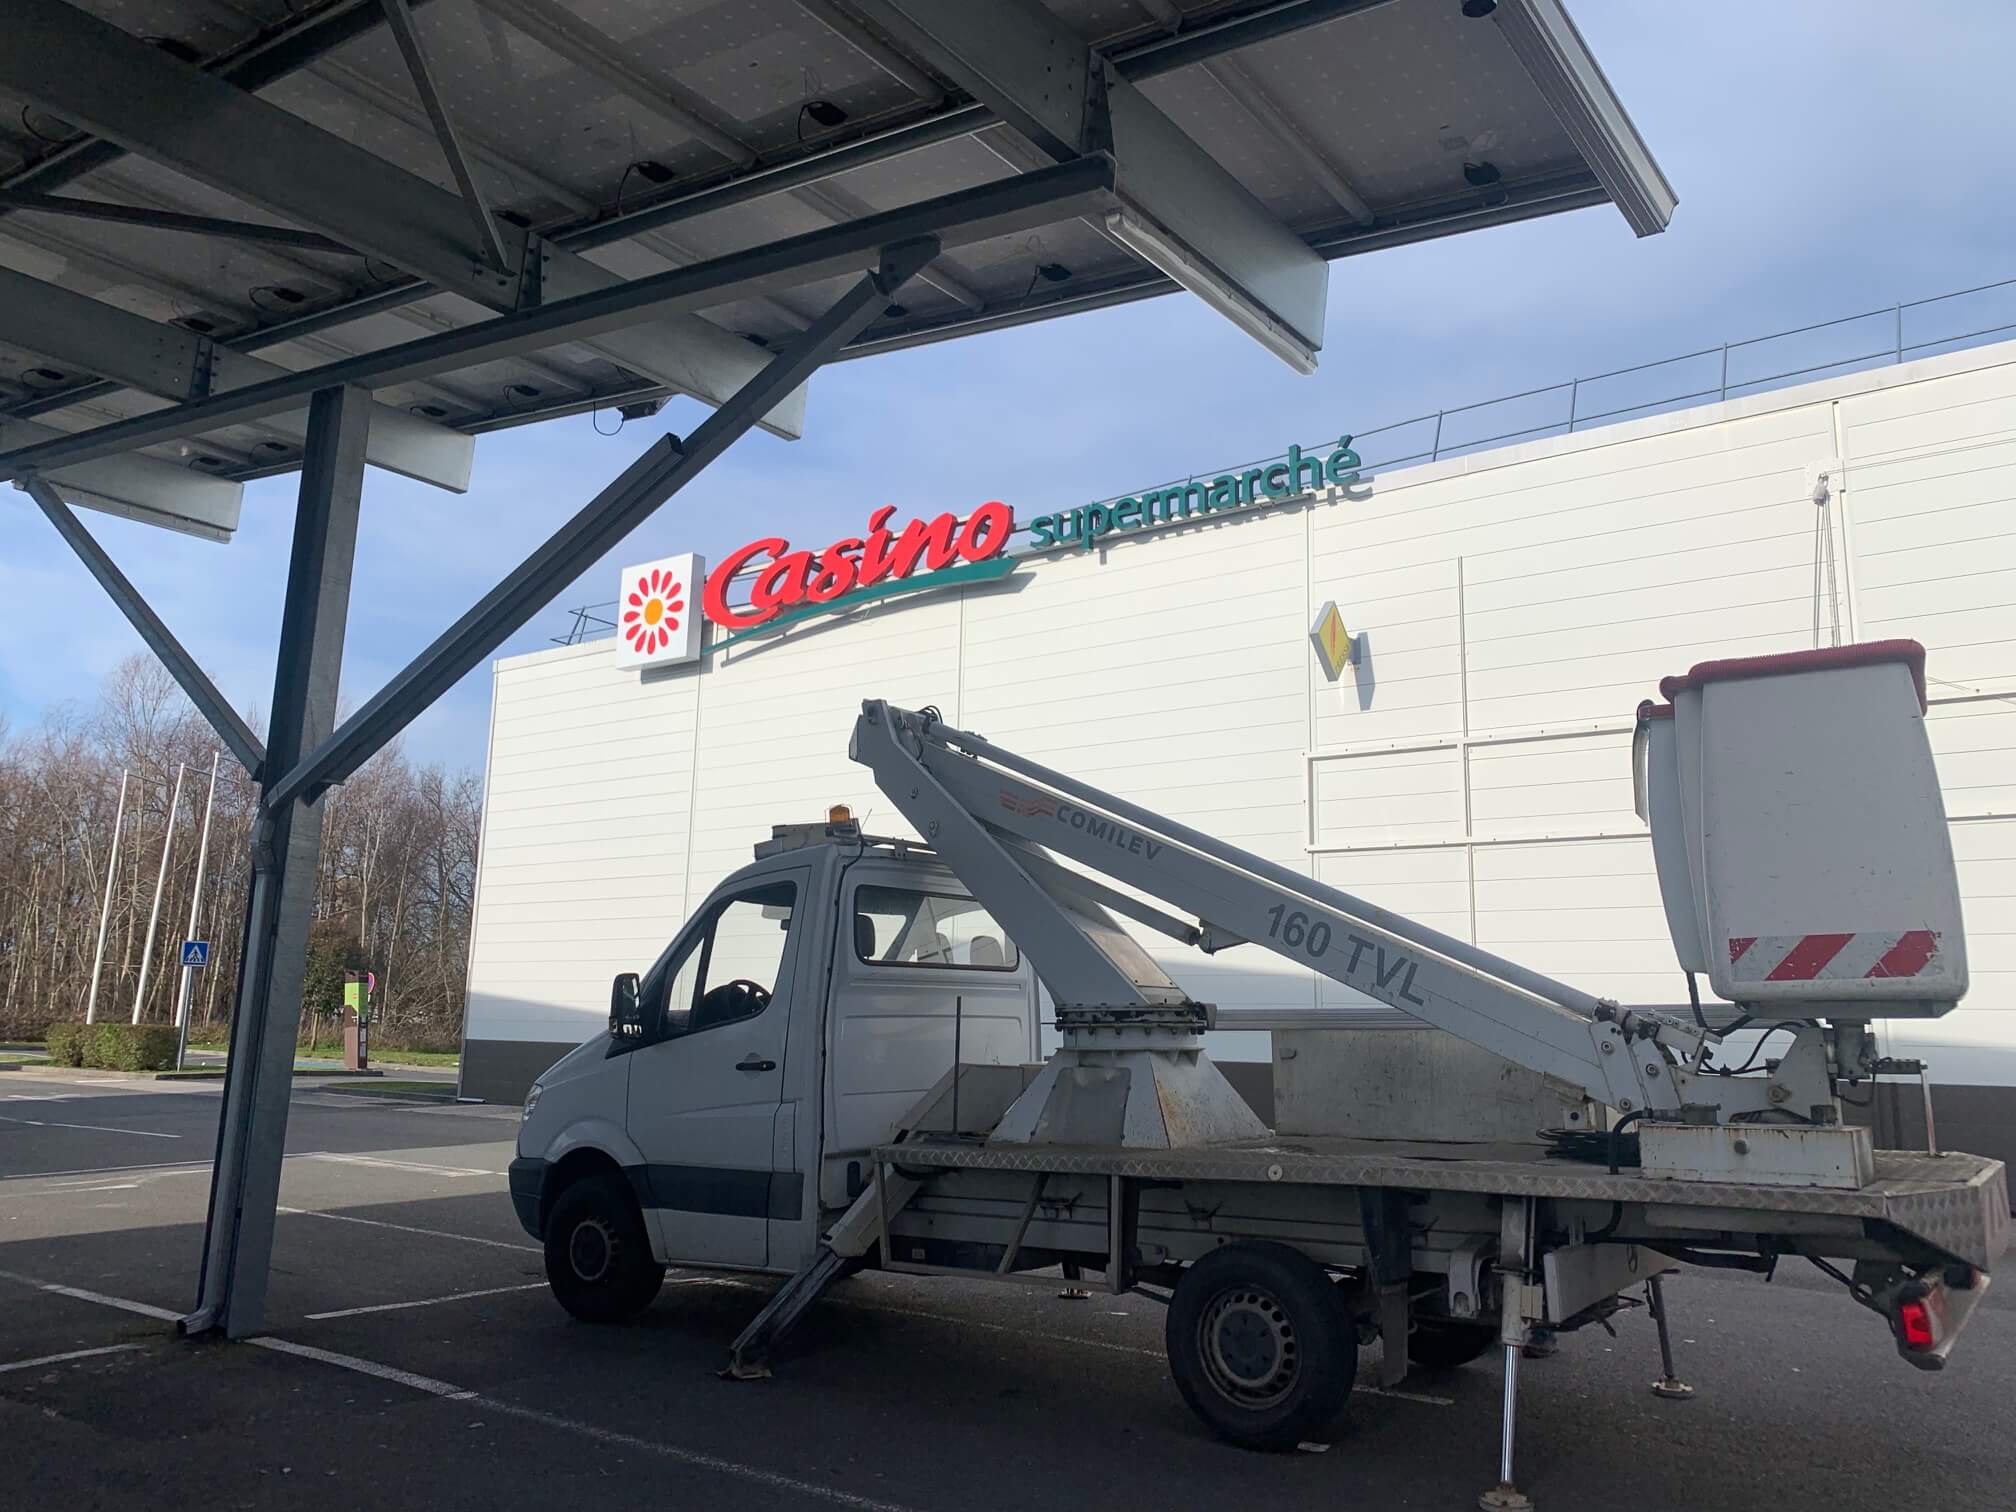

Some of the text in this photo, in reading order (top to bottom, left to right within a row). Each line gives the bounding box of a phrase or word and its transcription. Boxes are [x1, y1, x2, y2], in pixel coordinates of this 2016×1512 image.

[702, 436, 1361, 629] Casino supermarché
[1056, 806, 1162, 861] COMILEV
[1267, 903, 1425, 1006] 160 TVL
